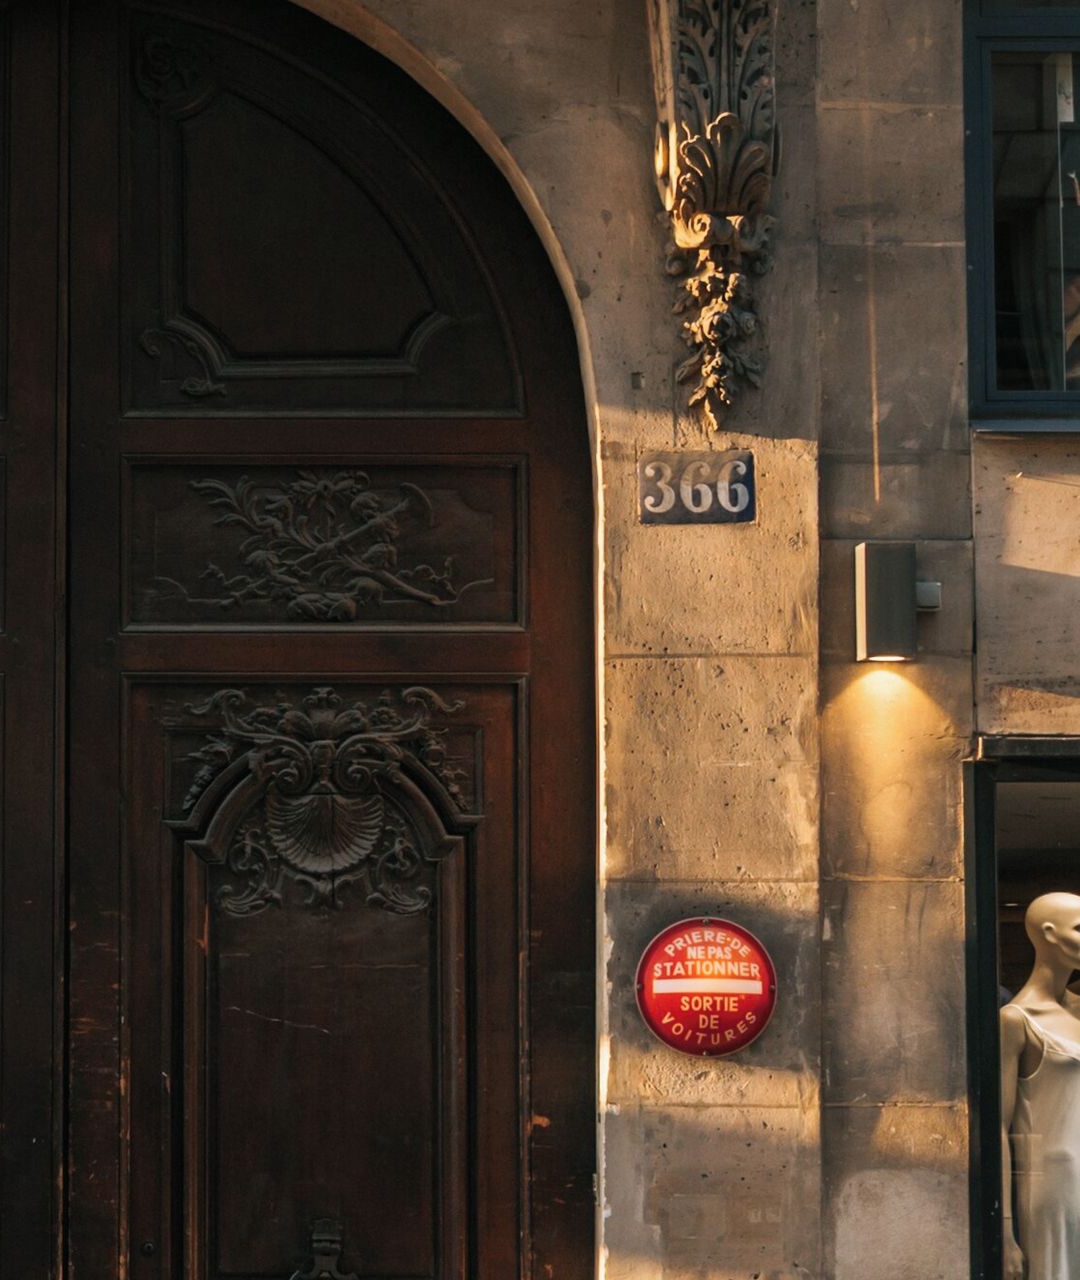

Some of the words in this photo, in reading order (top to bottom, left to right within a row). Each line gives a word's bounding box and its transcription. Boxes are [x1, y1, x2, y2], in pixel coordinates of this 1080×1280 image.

[644, 460, 750, 514] 366
[687, 946, 706, 960] NE
[707, 946, 732, 960] PAS
[654, 962, 760, 977] STATIONNER
[680, 996, 739, 1012] SORTIE
[662, 1012, 756, 1045] VOITURES
[699, 1014, 719, 1029] DE
